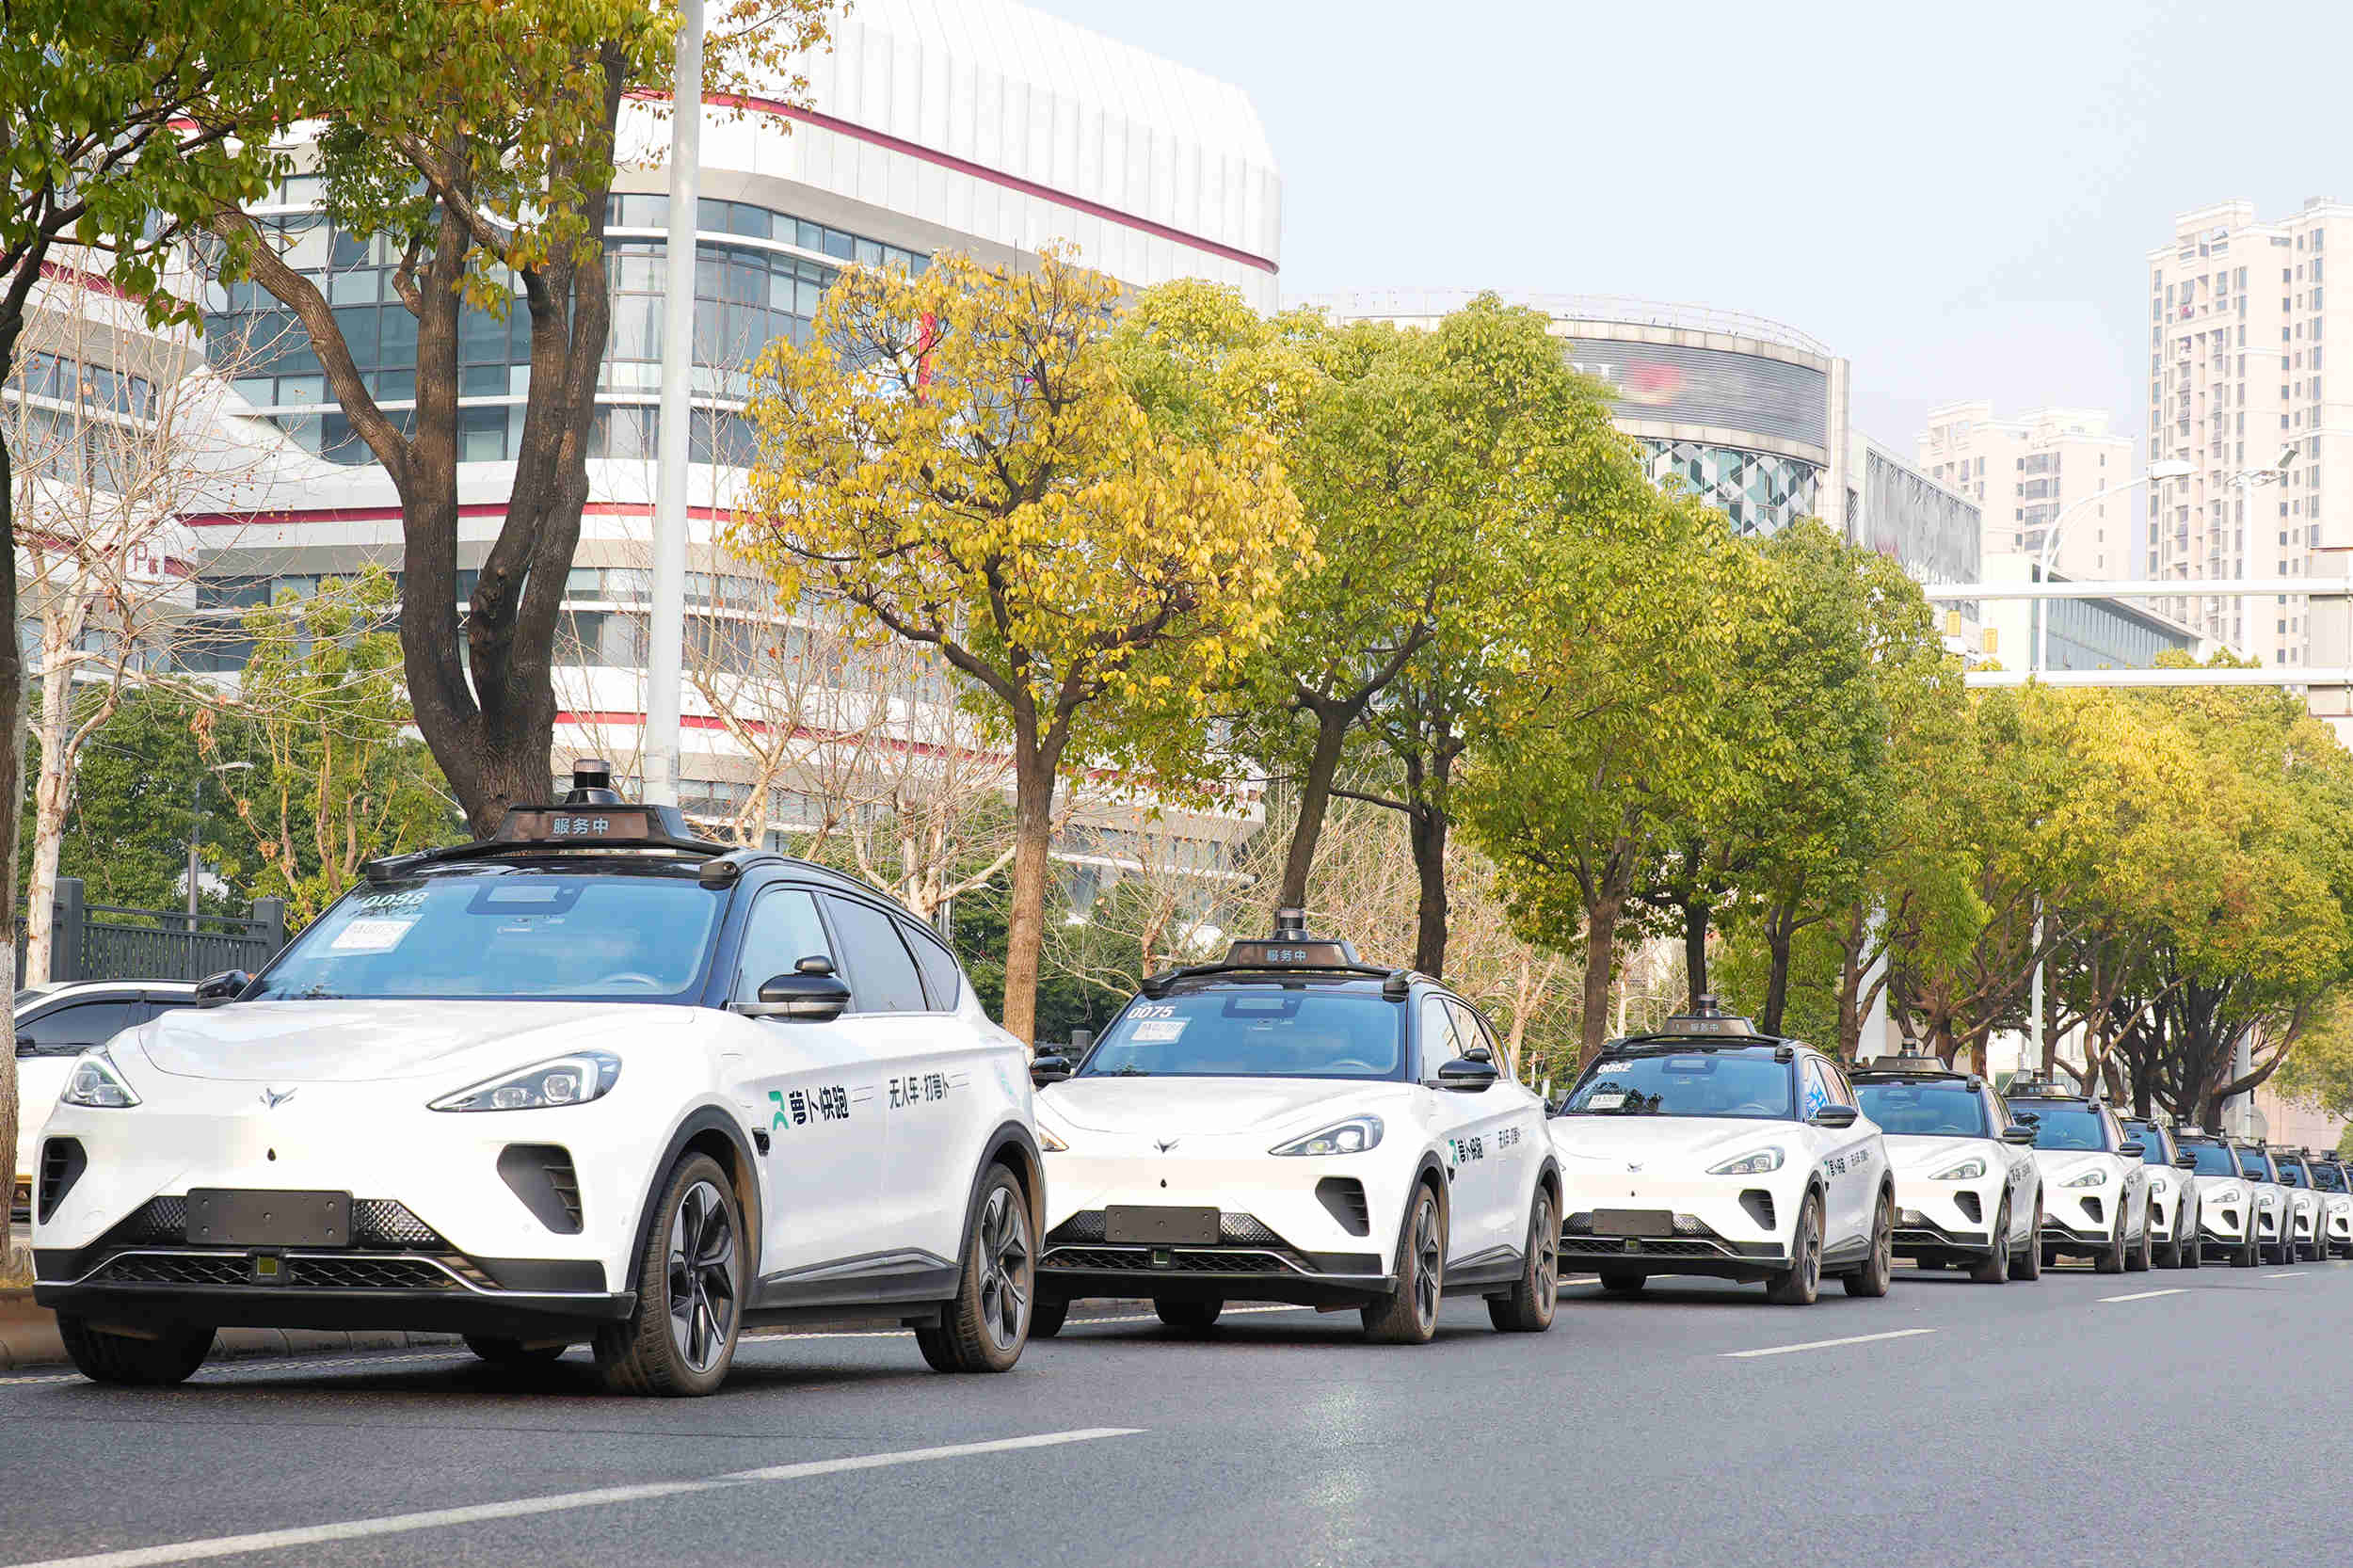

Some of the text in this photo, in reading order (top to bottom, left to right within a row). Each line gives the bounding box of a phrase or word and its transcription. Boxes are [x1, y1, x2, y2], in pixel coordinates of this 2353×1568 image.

[552, 817, 611, 836] 服务中
[1127, 1005, 1176, 1019] 0075
[789, 1085, 850, 1126] 萝卜快跑
